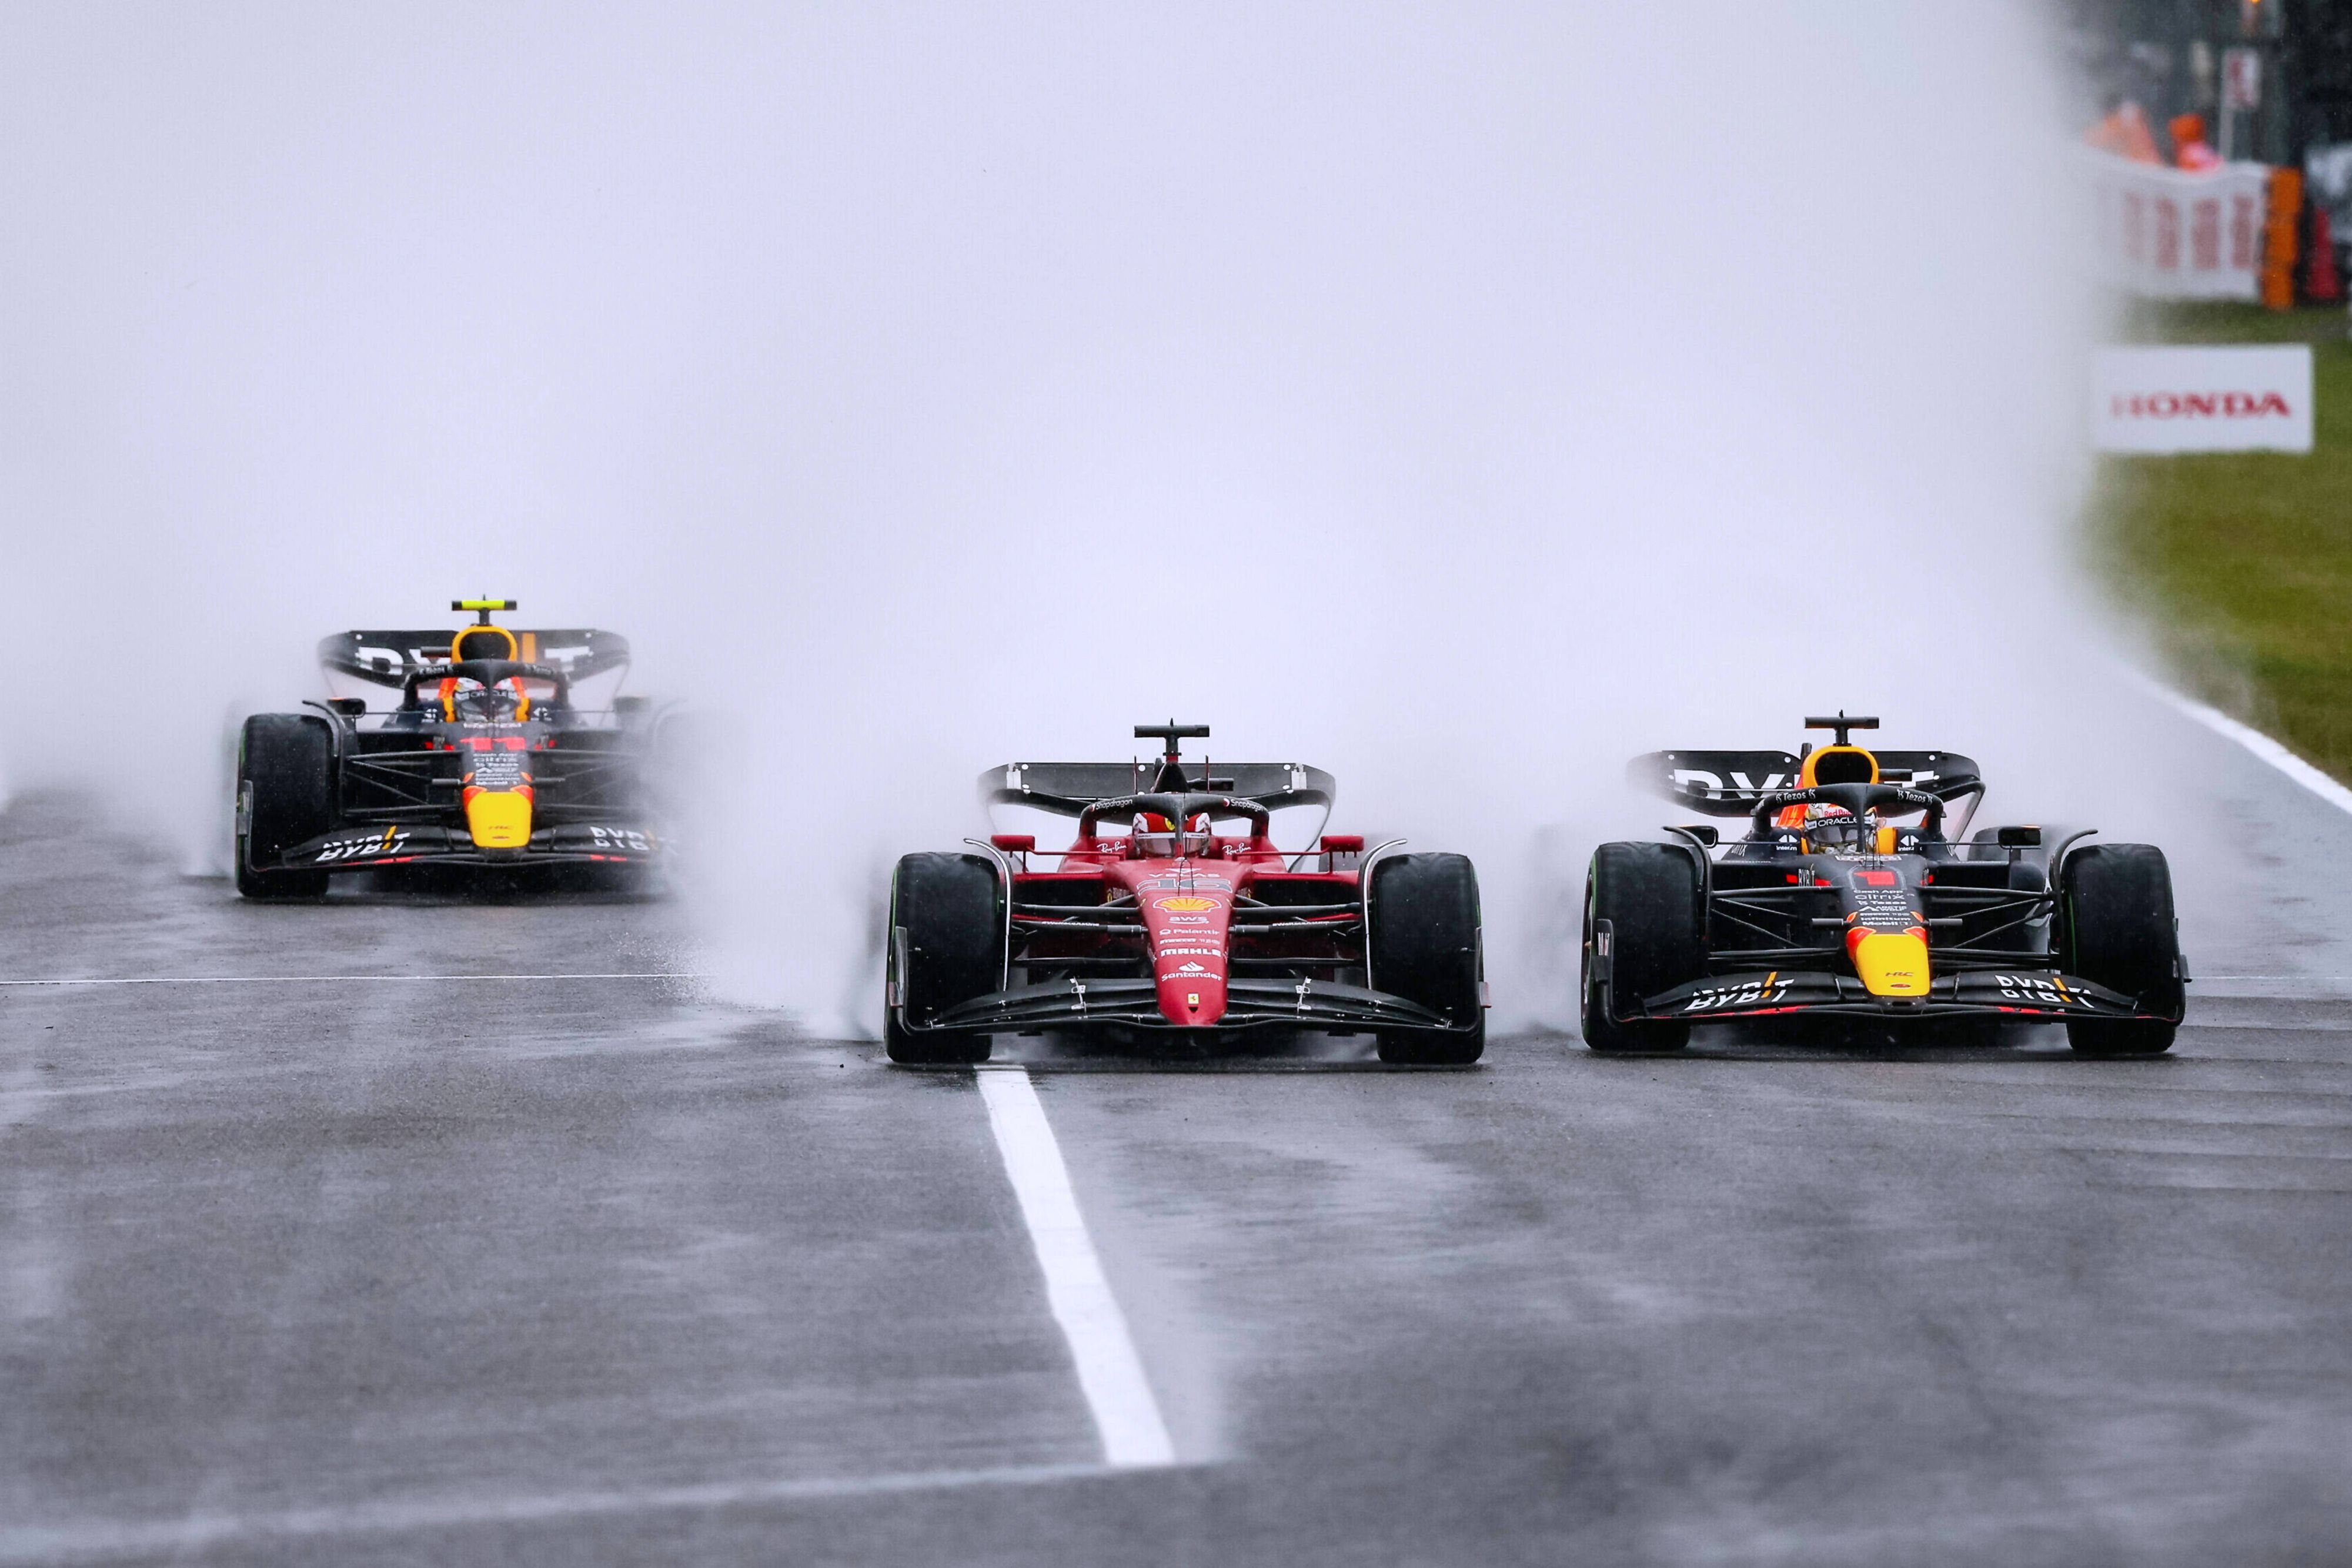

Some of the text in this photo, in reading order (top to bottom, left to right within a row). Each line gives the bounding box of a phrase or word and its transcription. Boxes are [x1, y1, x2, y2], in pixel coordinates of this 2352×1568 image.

[2111, 390, 2291, 419] HONDA
[1783, 791, 1806, 801] Tezos
[1905, 791, 1926, 803] Tezos
[1095, 799, 1133, 810] Snapdragon
[315, 825, 411, 862] BYBIT
[1853, 871, 1896, 886] 1
[1161, 948, 1221, 957] MAHLE
[1161, 972, 1222, 982] Santander
[1683, 971, 1795, 1011] BYBIT
[1995, 975, 2095, 1008] BYBIT
